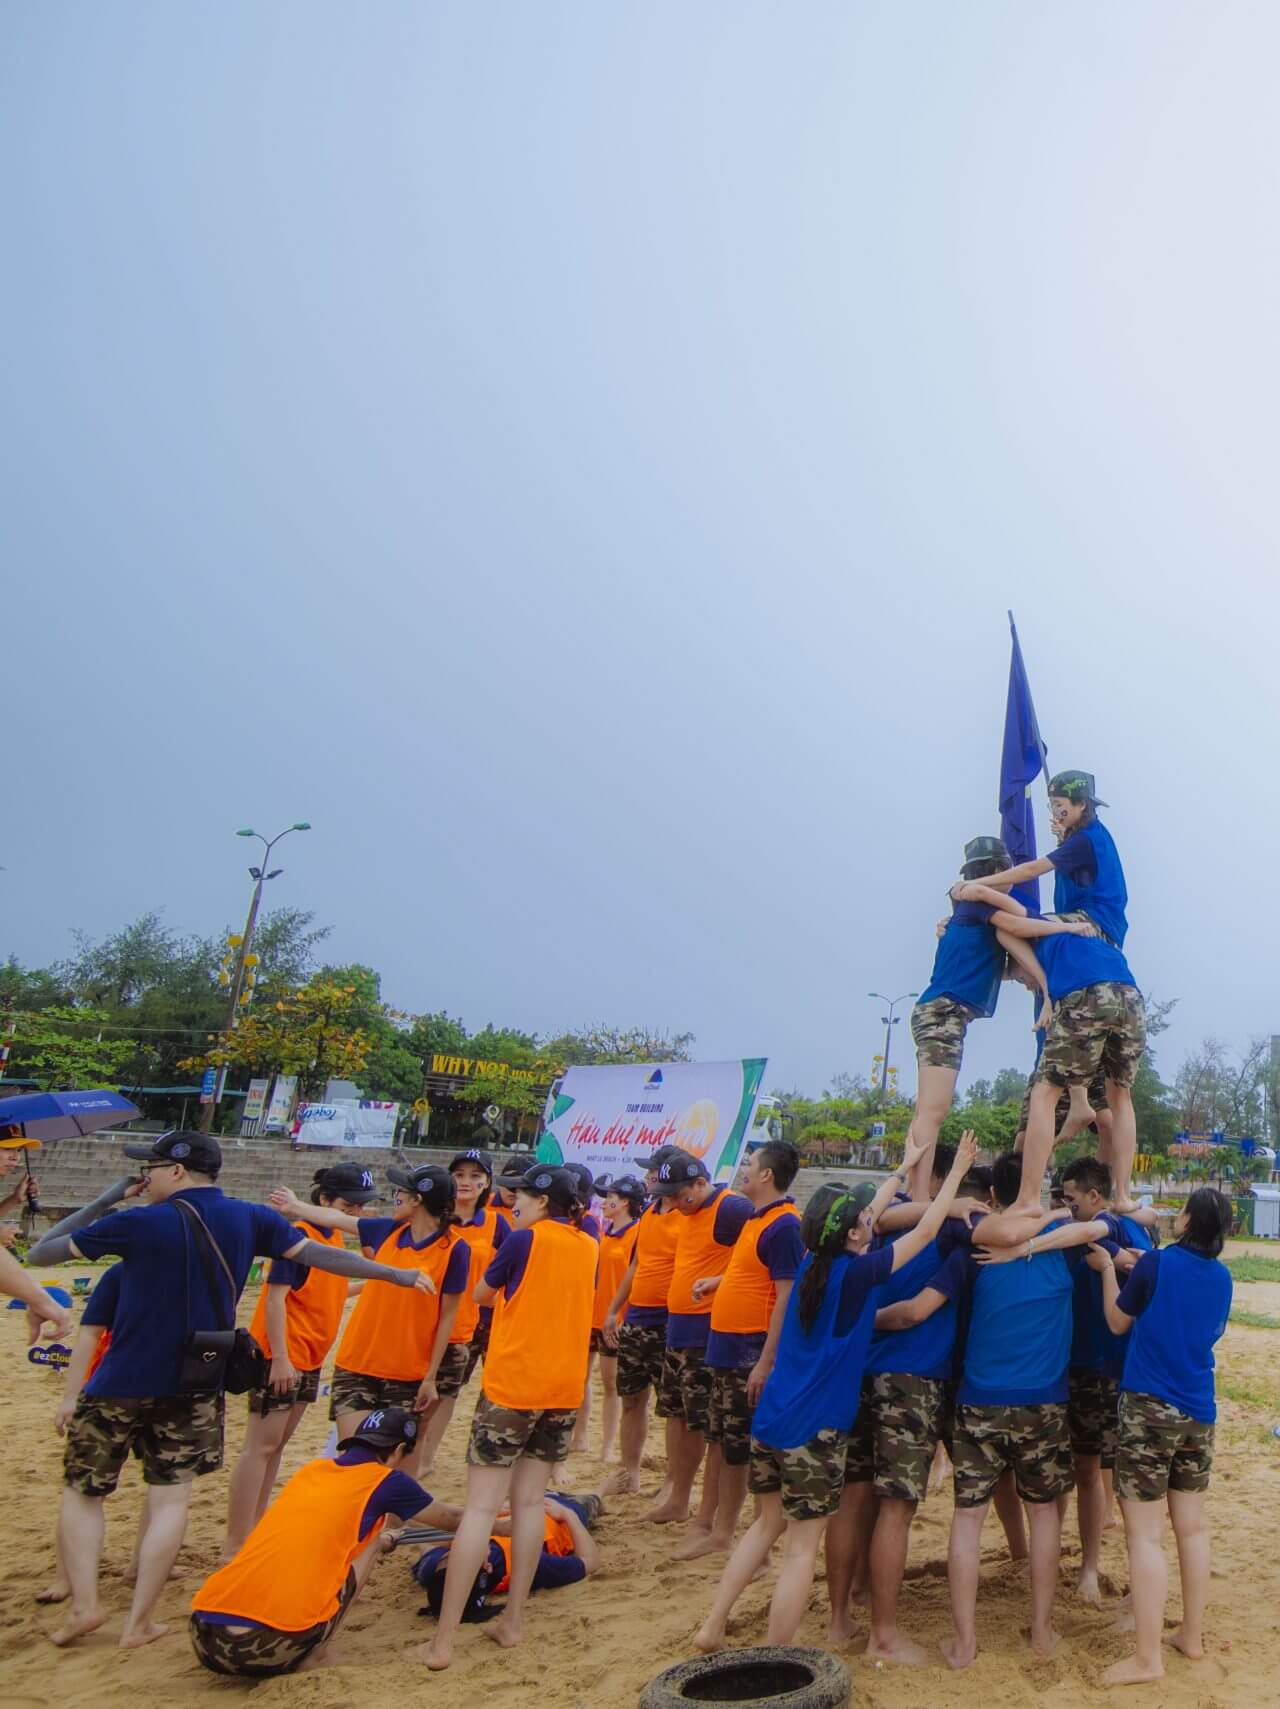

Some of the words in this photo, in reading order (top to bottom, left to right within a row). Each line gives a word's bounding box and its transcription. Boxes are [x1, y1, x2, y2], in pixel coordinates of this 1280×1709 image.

[432, 1055, 473, 1076] WHY
[476, 1060, 509, 1076] NOT
[566, 1113, 600, 1149] Hậu
[602, 1113, 637, 1152] duệ
[363, 1410, 385, 1429] NY
